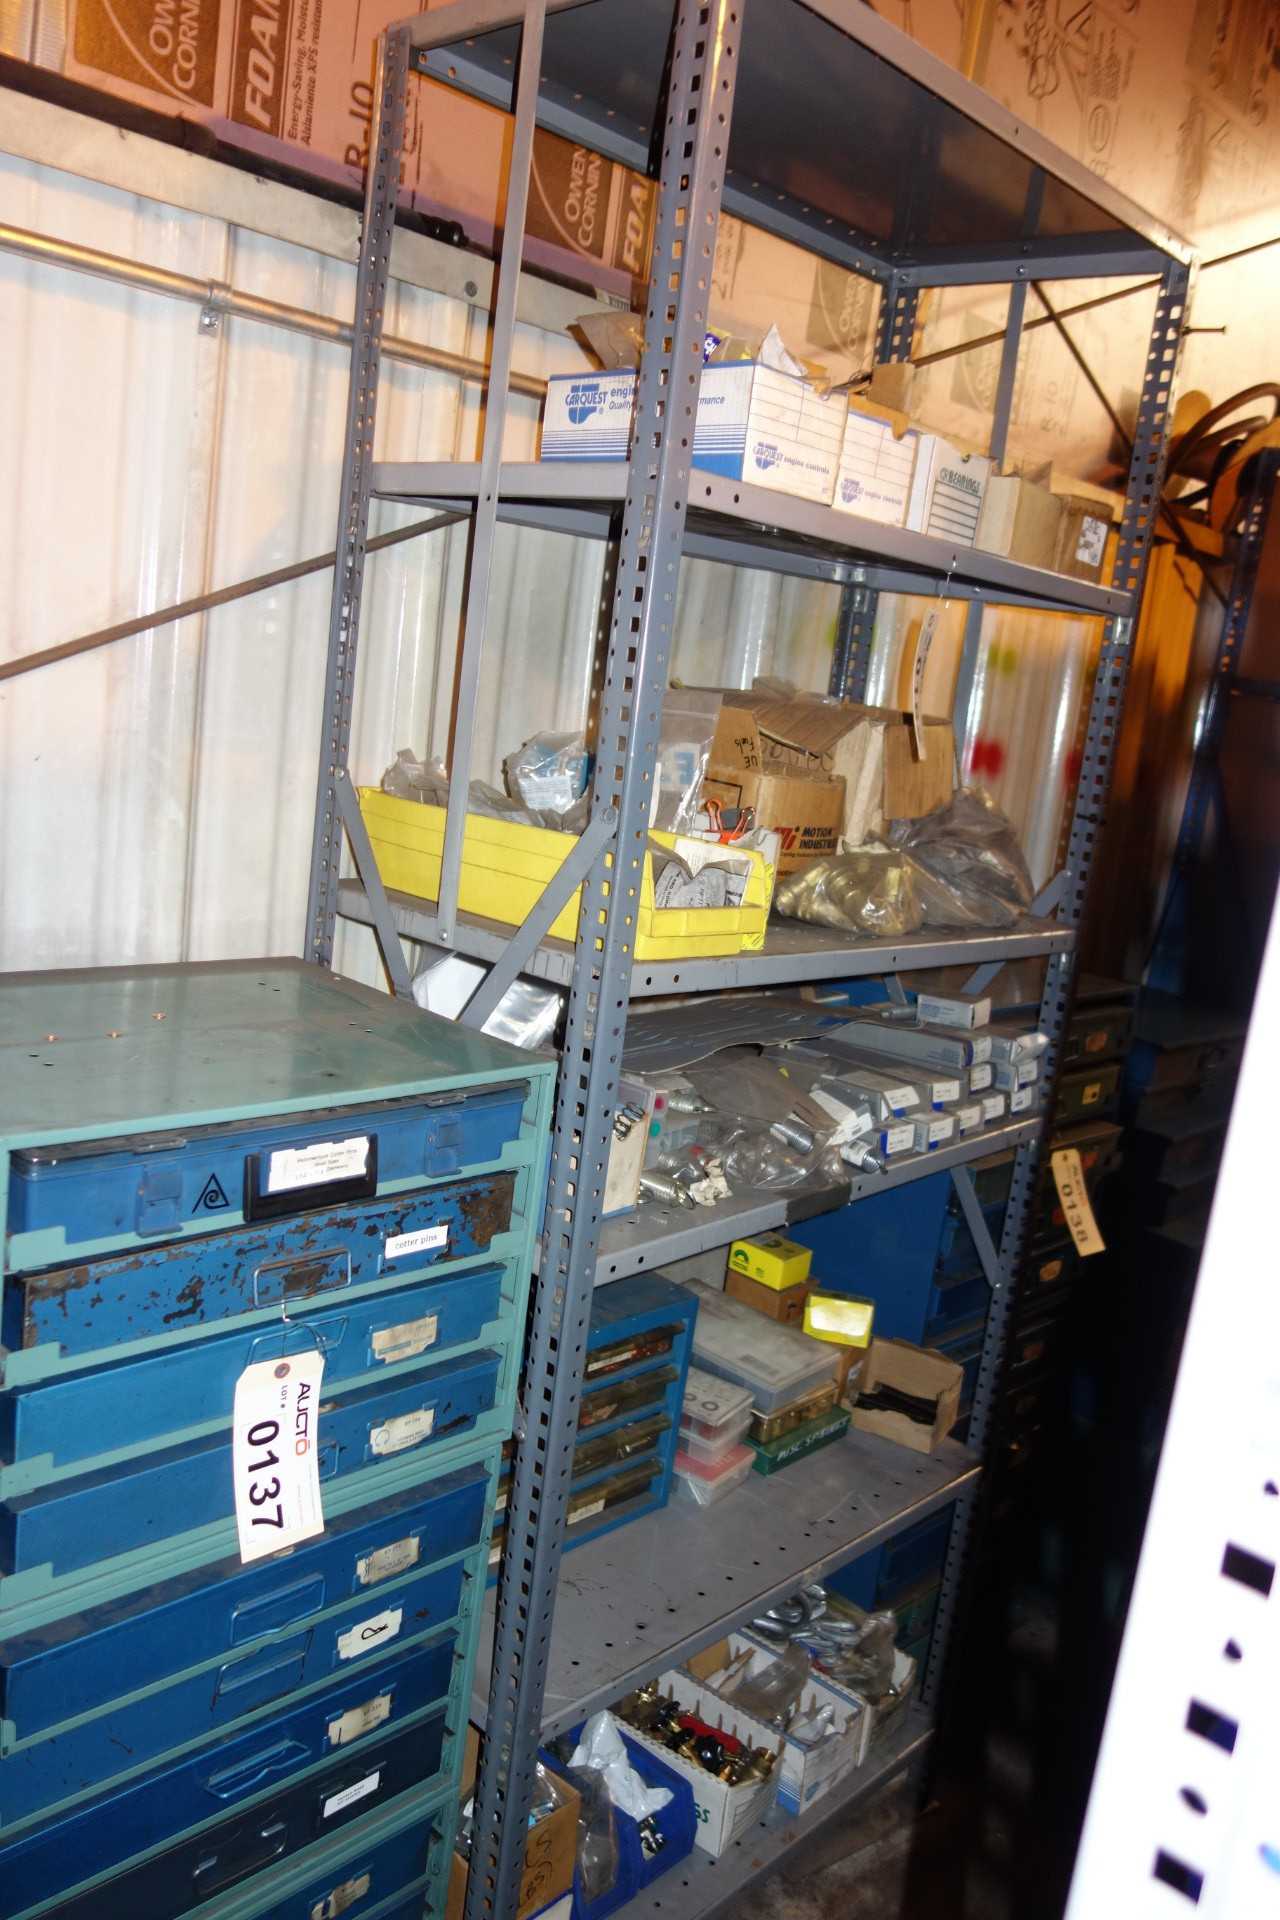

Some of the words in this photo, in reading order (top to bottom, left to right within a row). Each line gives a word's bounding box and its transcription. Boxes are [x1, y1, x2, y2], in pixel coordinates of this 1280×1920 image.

[565, 391, 608, 406] CARQUEST
[395, 1238, 419, 1249] cotter
[420, 1234, 437, 1245] pins
[248, 1420, 284, 1529] 0137
